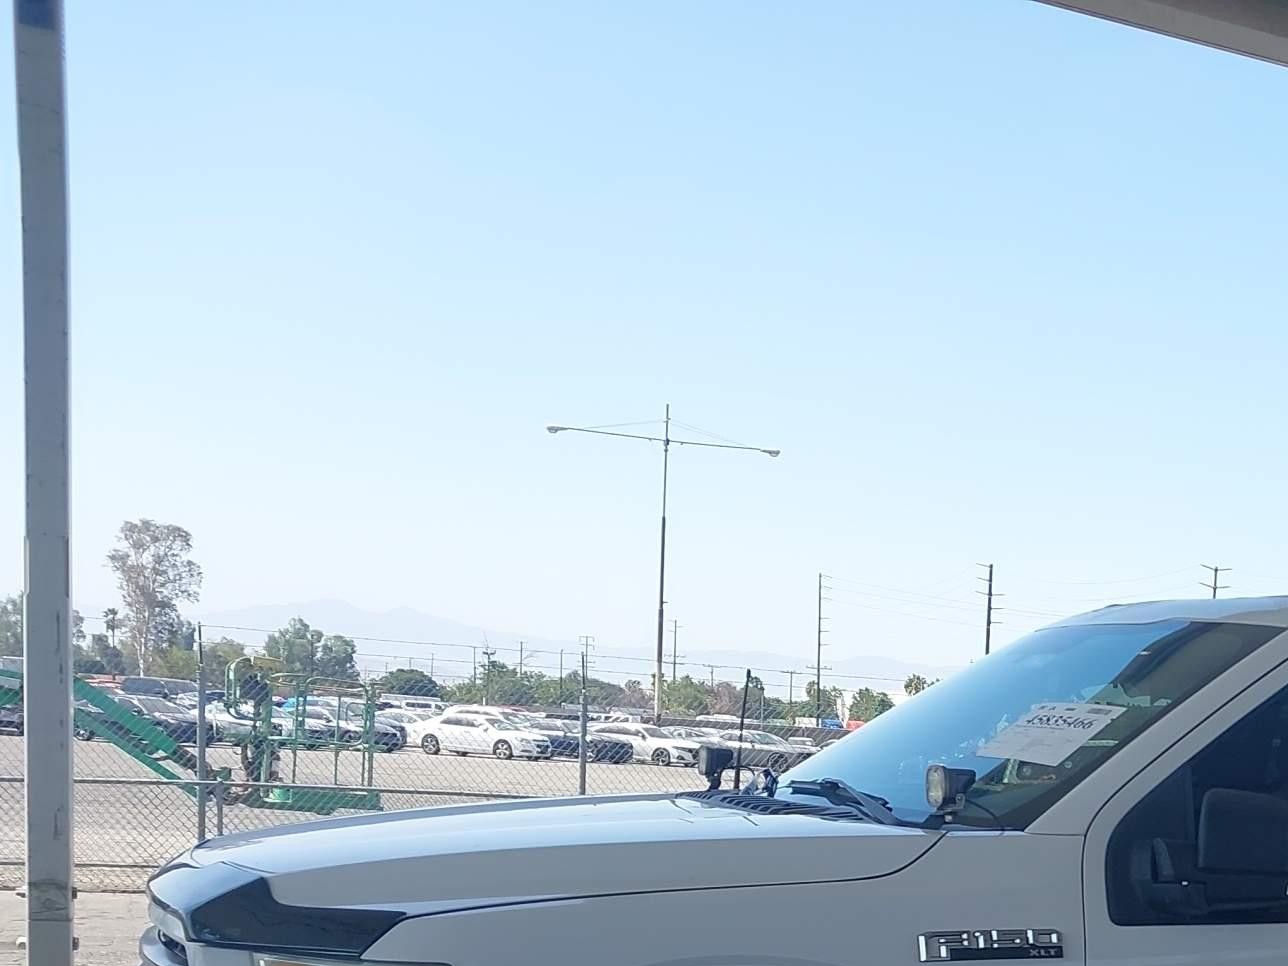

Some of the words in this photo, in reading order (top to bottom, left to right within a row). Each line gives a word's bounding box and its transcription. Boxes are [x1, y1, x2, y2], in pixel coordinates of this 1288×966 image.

[1024, 713, 1095, 730] 45835466
[918, 929, 1062, 962] F150
[1028, 948, 1058, 957] XLT
